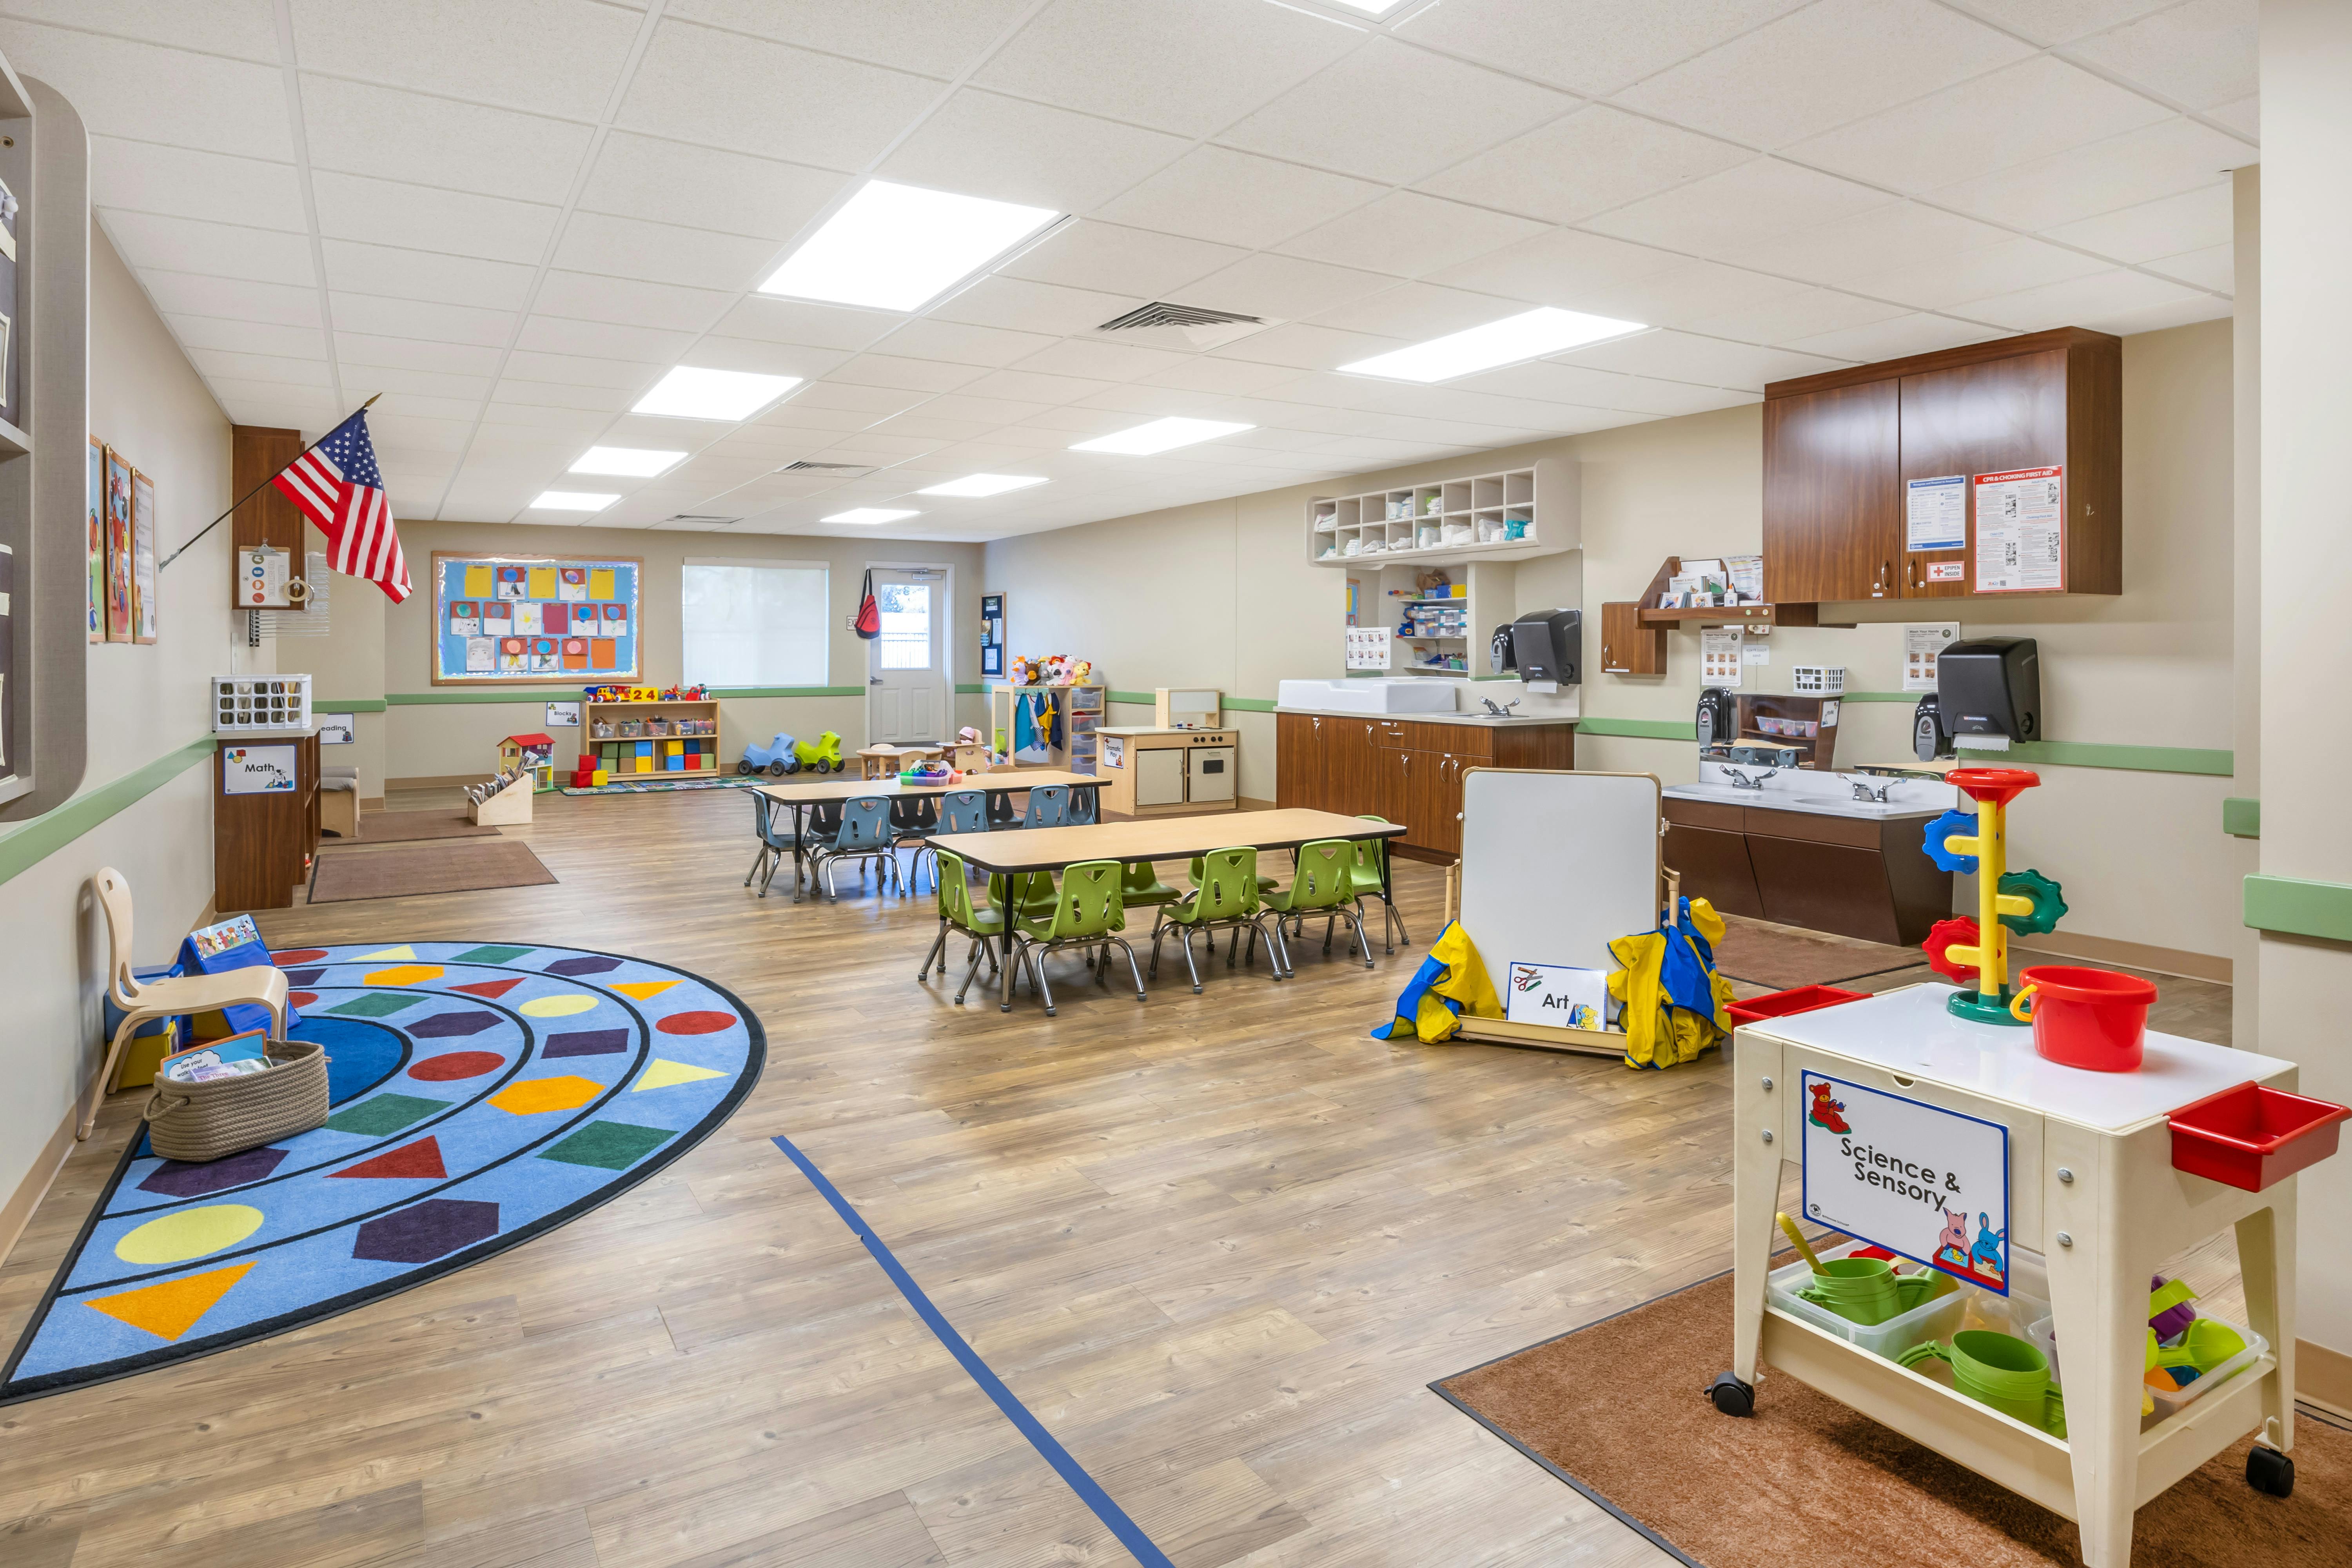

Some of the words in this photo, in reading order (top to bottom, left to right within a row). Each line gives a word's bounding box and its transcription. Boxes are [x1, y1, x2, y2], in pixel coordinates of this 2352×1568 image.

[1999, 472, 2025, 481] CHOKING
[633, 690, 642, 700] 2
[646, 690, 655, 700] 4
[245, 763, 274, 772] Math
[1542, 993, 1569, 1009] Art
[1841, 1137, 1936, 1184] Science
[1945, 1172, 1962, 1194] &
[1854, 1161, 1947, 1212] Sensory
